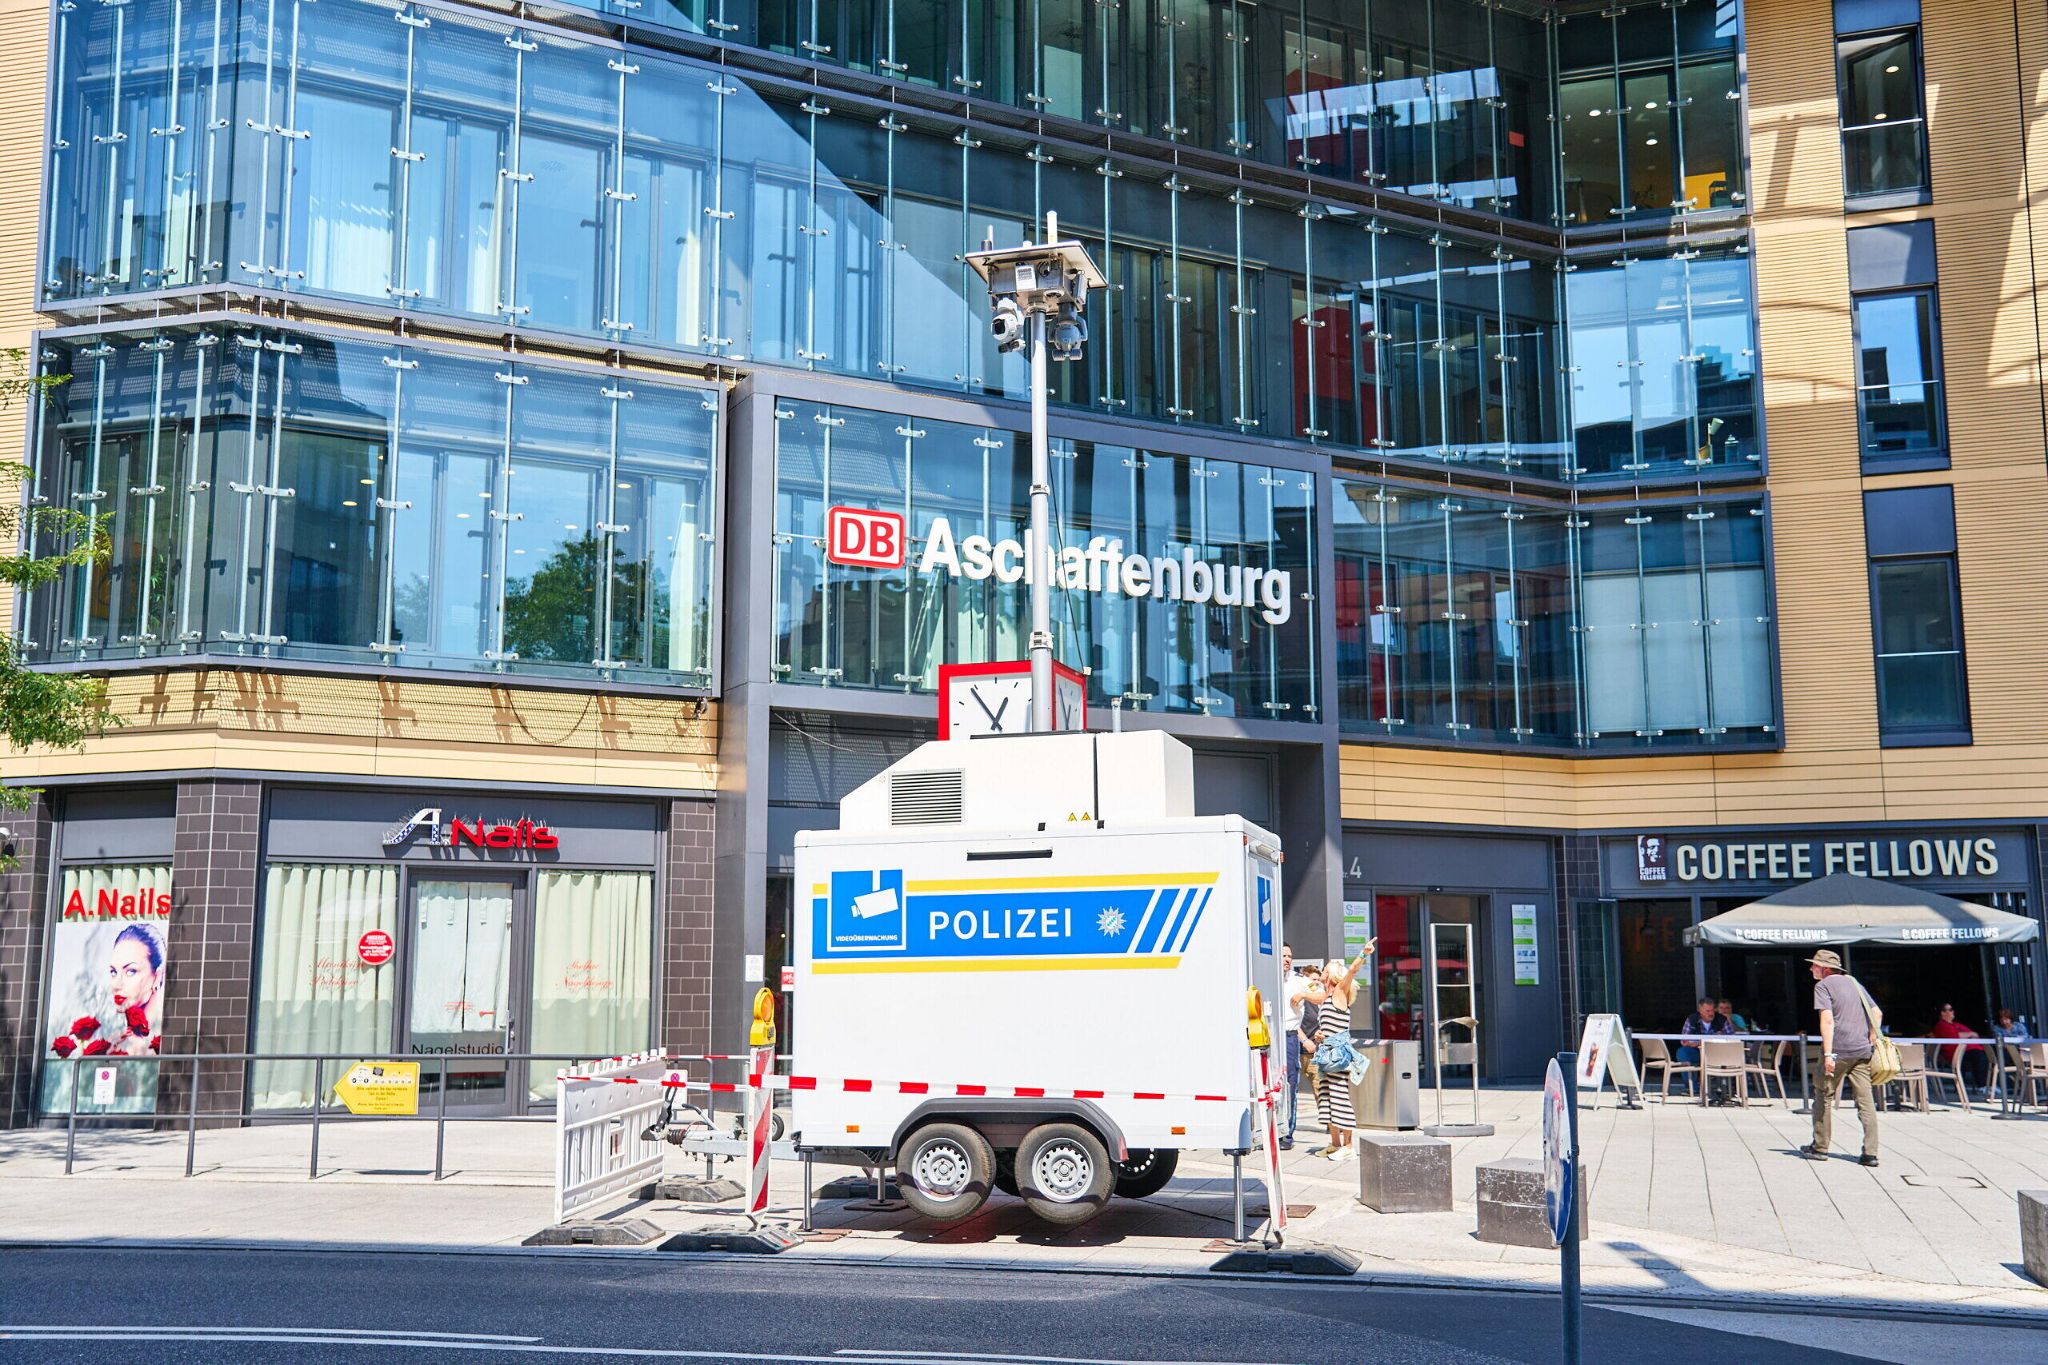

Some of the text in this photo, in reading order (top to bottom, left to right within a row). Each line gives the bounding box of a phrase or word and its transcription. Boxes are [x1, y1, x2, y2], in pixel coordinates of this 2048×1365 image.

[839, 517, 895, 558] DB
[918, 517, 1292, 625] Aschaffenburg
[1349, 856, 1362, 879] 4
[1639, 866, 1666, 874] COFFEE
[1676, 838, 2000, 881] COFFEE FELLOWS
[64, 888, 172, 917] A.Nails
[928, 907, 1072, 940] POLIZEI
[1743, 928, 1828, 941] COFFEE FELLOWS
[1910, 927, 2000, 940] COFFEE FELLOWS
[835, 933, 899, 943] VIDEOÜBERWACHUNG
[412, 1043, 505, 1055] Nagelstudio
